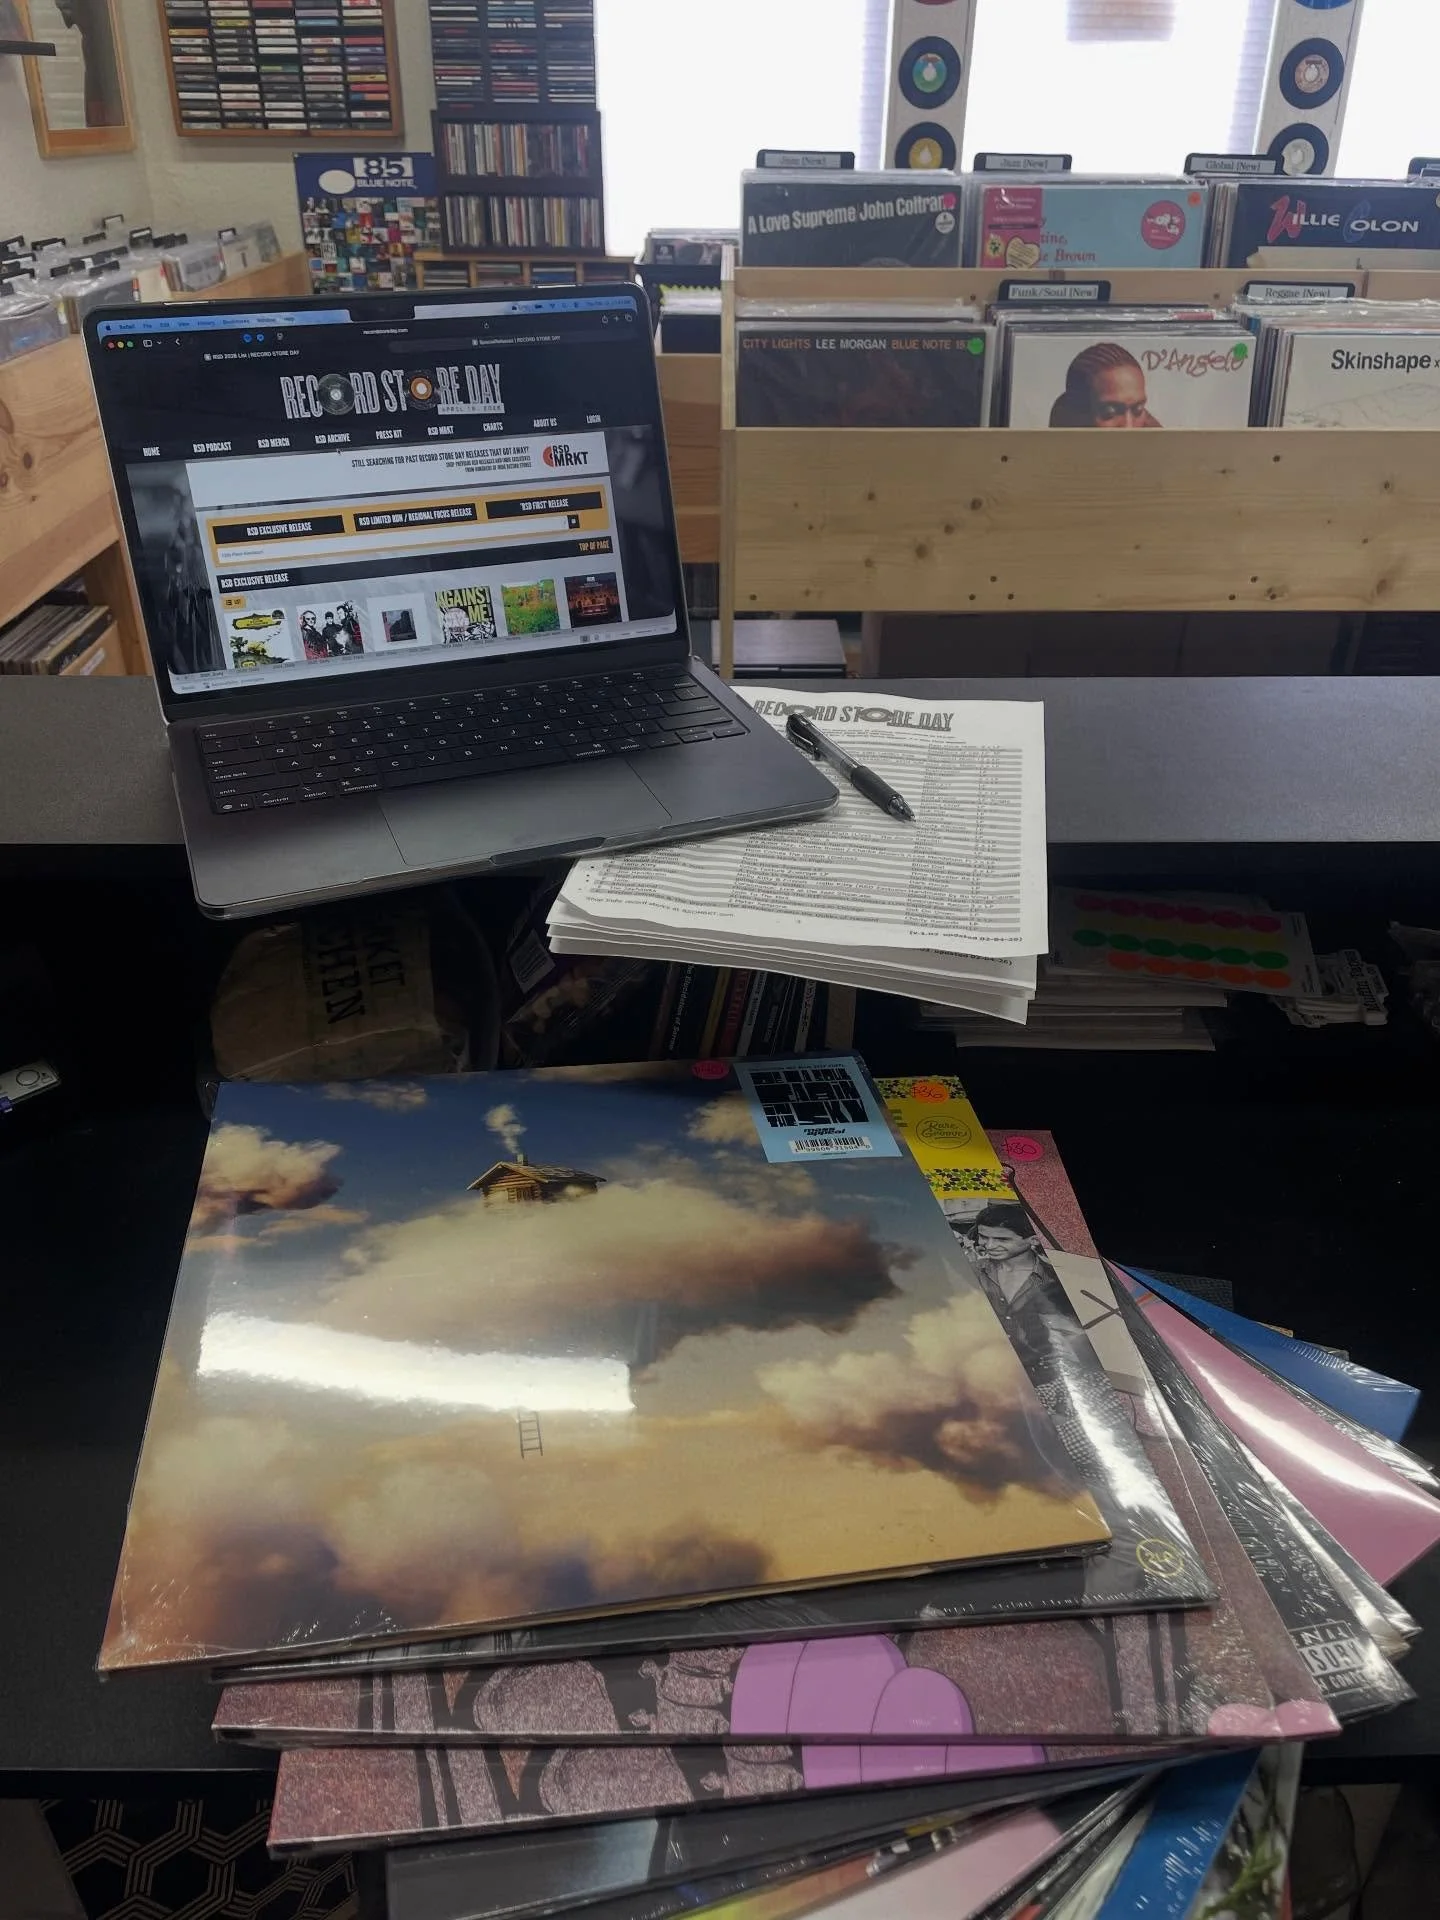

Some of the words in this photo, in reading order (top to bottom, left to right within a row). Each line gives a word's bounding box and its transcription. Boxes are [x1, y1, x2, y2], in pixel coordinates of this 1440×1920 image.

[1206, 159, 1234, 172] Global
[1236, 160, 1262, 172] [New]
[356, 178, 384, 188] BLUE
[385, 178, 415, 188] NOTE
[747, 215, 758, 236] A
[759, 212, 791, 235] Love
[792, 205, 857, 231] Supreme
[859, 200, 895, 222] John
[895, 193, 955, 216] Coltran
[1267, 194, 1341, 244] WILLIE
[1342, 200, 1419, 243] COLON
[1054, 249, 1096, 262] Brown
[1010, 286, 1067, 298] Funk/Soul
[1069, 286, 1098, 299] [New]
[1264, 287, 1300, 298] Reggae
[742, 339, 768, 350] CITY
[772, 338, 812, 350] LIGHTS
[816, 338, 836, 350] LEE
[840, 338, 887, 350] MORGAN
[891, 339, 919, 350] BLUE
[922, 339, 951, 350] NOTE
[1142, 345, 1248, 378] D'Angelo
[1330, 348, 1432, 374] Skinshape
[279, 371, 381, 420] RECORD
[381, 365, 461, 412] STORE
[464, 363, 502, 406] DAY
[142, 446, 161, 457] HOME
[193, 443, 206, 454] RSD
[206, 441, 232, 453] PODCAST
[258, 438, 270, 449] RSD
[270, 437, 290, 448] MERCH
[314, 434, 326, 444] RSD
[327, 432, 351, 444] ARCHIVE
[375, 430, 390, 440] PRESS
[391, 428, 404, 439] KIT
[482, 421, 504, 432] CHARTS
[533, 418, 550, 429] ABOUT
[550, 416, 558, 427] US
[351, 457, 366, 468] STILL
[366, 455, 394, 468] SEARCHING
[394, 454, 405, 466] FOR
[405, 453, 418, 464] PAST
[418, 451, 438, 464] RECORD
[438, 450, 454, 462] STORE
[455, 448, 466, 460] DAY
[466, 447, 489, 460] RELEASES
[488, 446, 502, 458] THAT
[502, 446, 513, 456] GOT
[552, 444, 570, 454] RSD
[554, 451, 589, 468] MRKT
[548, 498, 569, 508] RELEASE
[358, 516, 370, 526] RSD
[370, 514, 392, 526] LIMITED
[392, 512, 404, 524] RUN
[408, 510, 434, 523] REGIONAL
[433, 508, 451, 520] FOCUS
[450, 507, 473, 519] RELEASE
[246, 526, 260, 536] RSD
[259, 524, 288, 535] EXCLUSIVE
[288, 522, 313, 533] RELEASE
[578, 541, 589, 552] TOP
[589, 540, 597, 551] OF
[597, 540, 610, 550] PAGE
[220, 578, 234, 589] RSD
[234, 574, 264, 588] EXCLUSIVE
[264, 572, 289, 584] RELEASE
[435, 586, 490, 609] AGAINST
[754, 699, 836, 722] RECORD
[839, 705, 914, 728] STORE
[918, 710, 955, 731] DAY
[263, 796, 290, 805] control
[304, 790, 328, 800] option
[344, 782, 378, 793] command
[911, 1085, 943, 1099] $36
[1001, 1136, 1038, 1155] $30
